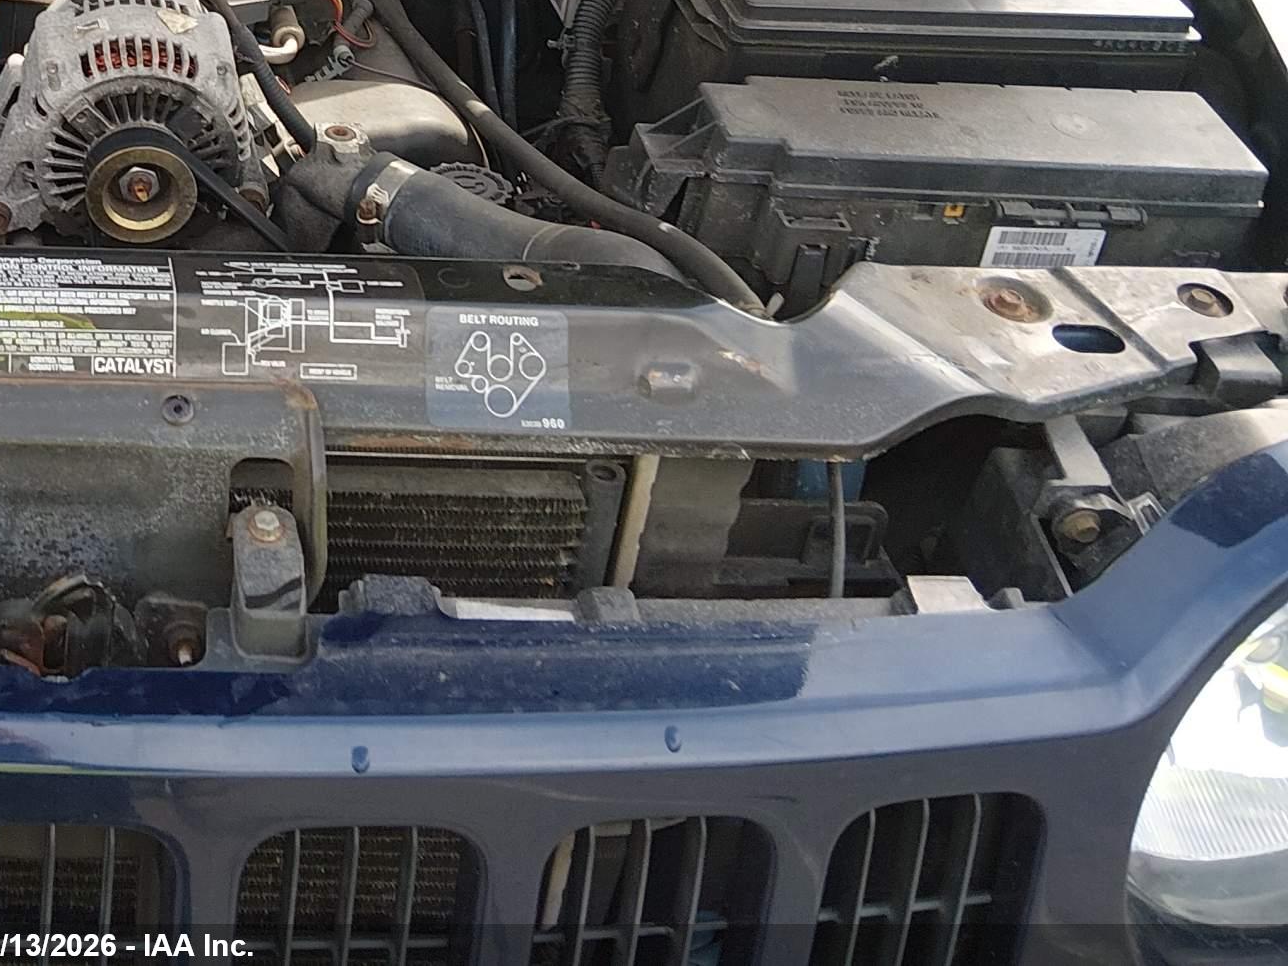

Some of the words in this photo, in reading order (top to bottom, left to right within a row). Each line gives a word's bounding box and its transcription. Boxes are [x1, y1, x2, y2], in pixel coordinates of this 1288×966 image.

[37, 256, 102, 266] Corporation
[21, 263, 75, 272] CONTROL
[78, 265, 158, 274] INFORMATION
[459, 313, 487, 325] BELT
[489, 314, 539, 327] ROUTING
[94, 357, 173, 374] CATALYST
